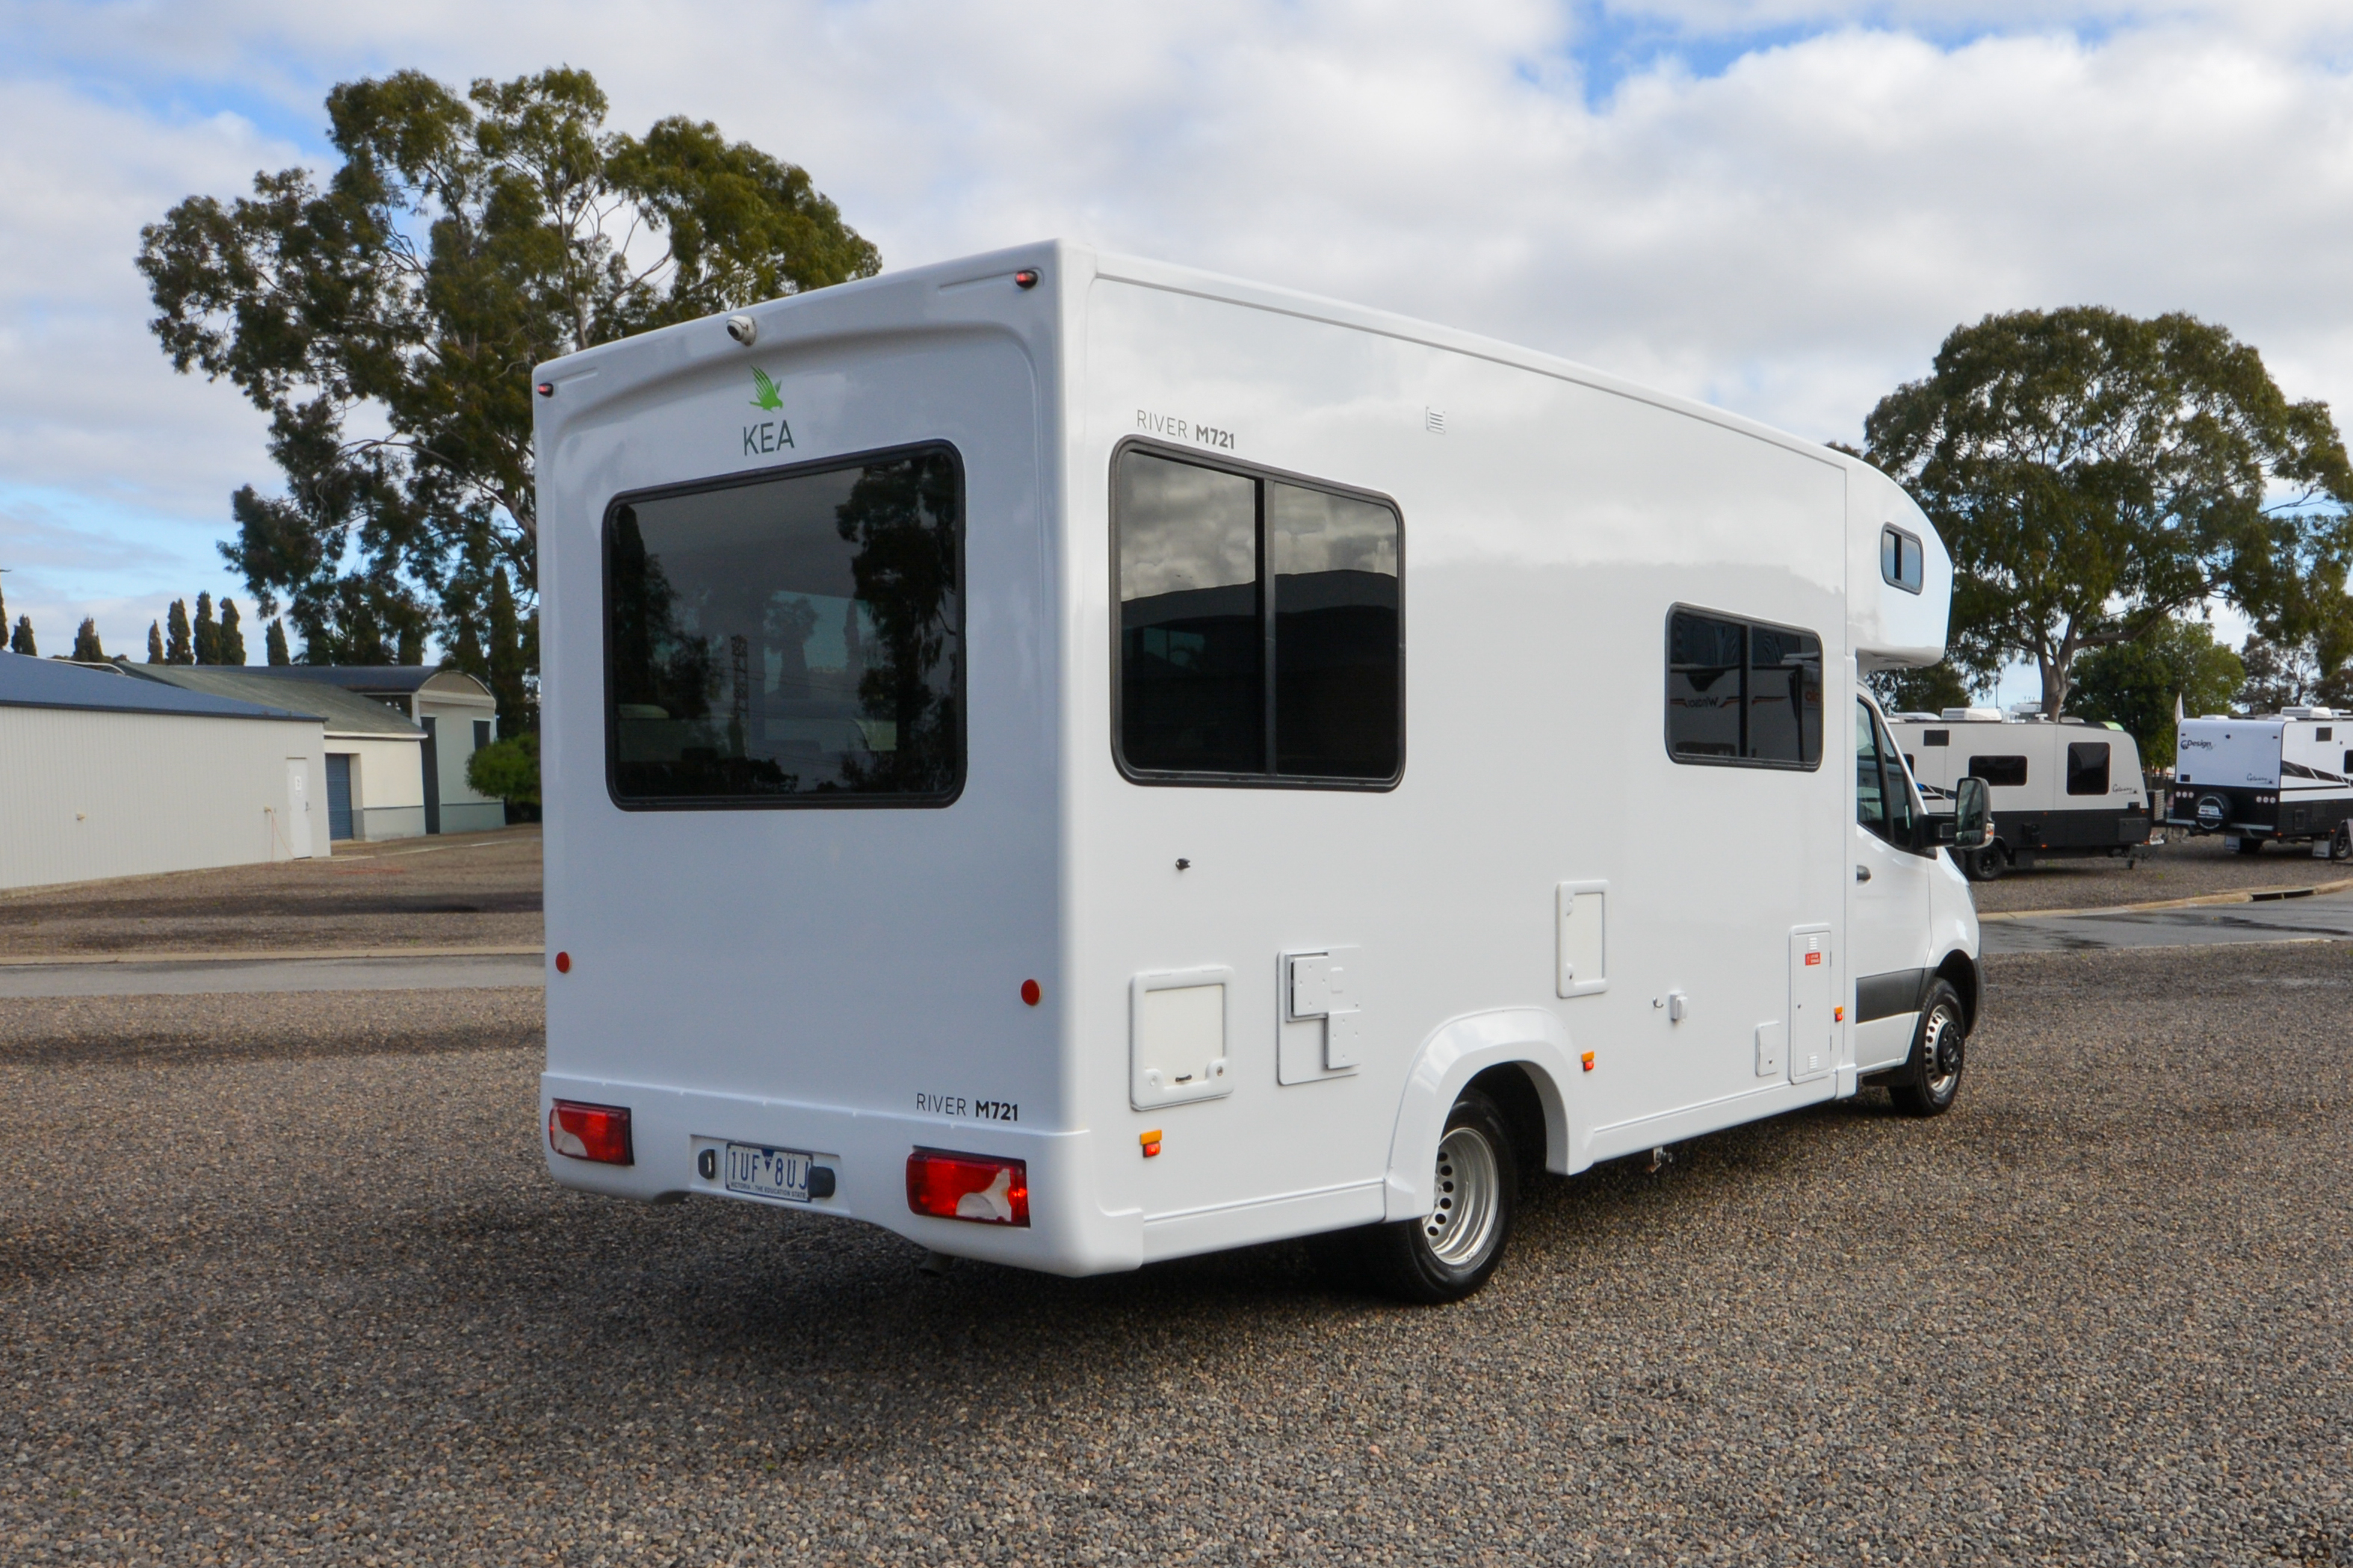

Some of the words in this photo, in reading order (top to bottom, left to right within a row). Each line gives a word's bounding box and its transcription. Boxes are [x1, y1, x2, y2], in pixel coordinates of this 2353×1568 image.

[743, 419, 795, 456] KEA
[1137, 409, 1187, 439] RIVER
[1196, 424, 1234, 449] M721
[2188, 740, 2212, 749] Design
[916, 1093, 966, 1116] RIVER
[976, 1100, 1018, 1121] M721
[732, 1151, 760, 1183] 1UF
[775, 1158, 808, 1189] 8UJ
